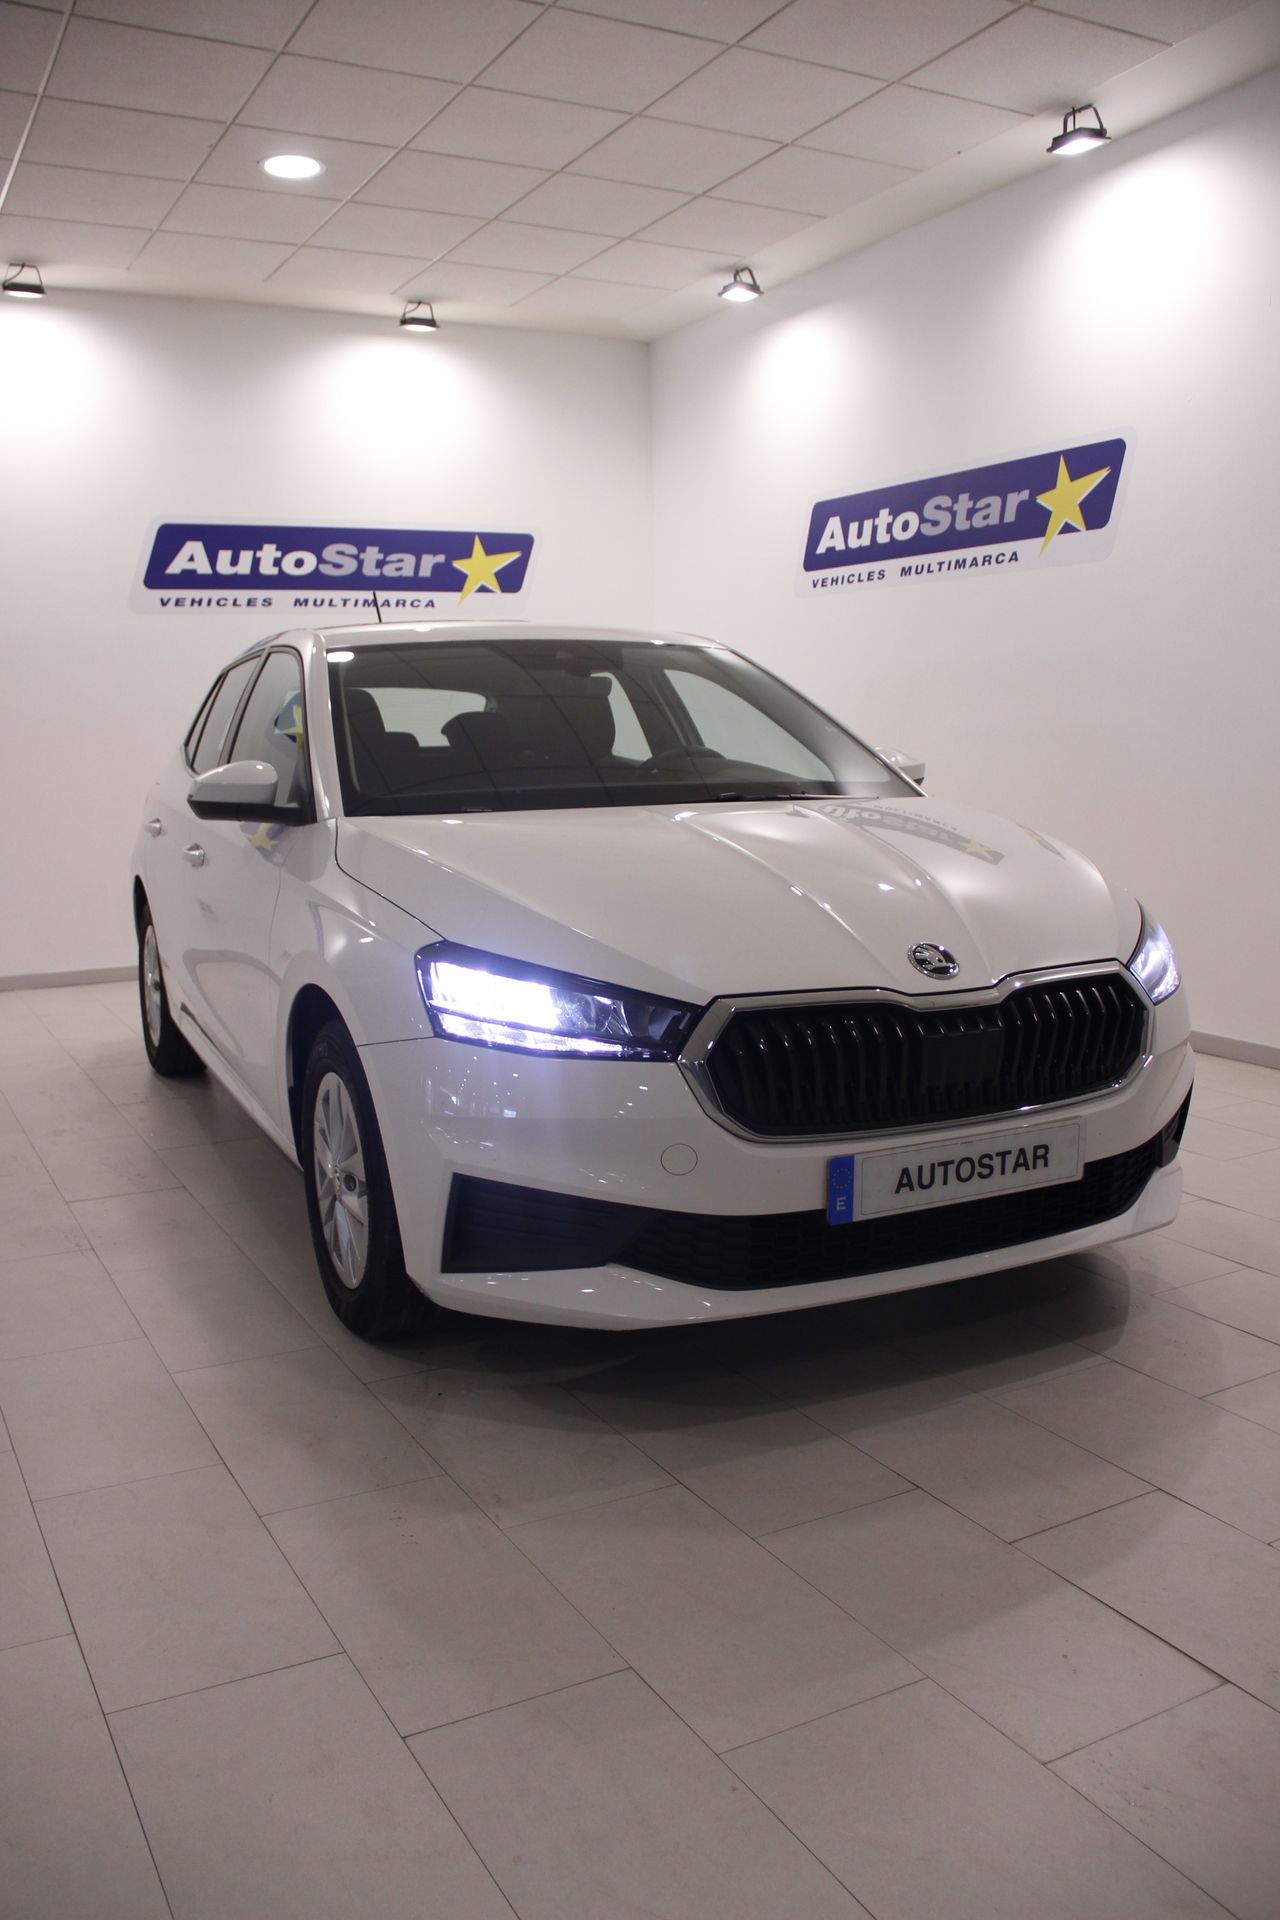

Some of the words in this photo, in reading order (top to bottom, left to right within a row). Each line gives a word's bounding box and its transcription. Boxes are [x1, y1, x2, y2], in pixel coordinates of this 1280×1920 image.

[816, 489, 1030, 554] AutoStar
[165, 540, 446, 577] AutoStar
[812, 569, 887, 588] VEHICLES
[900, 551, 1020, 577] MULTIMARCA
[160, 597, 273, 608] VEHICLES
[294, 598, 436, 608] MULTIMARCA
[894, 1144, 1050, 1194] AUTOSTAR
[836, 1197, 846, 1211] E
